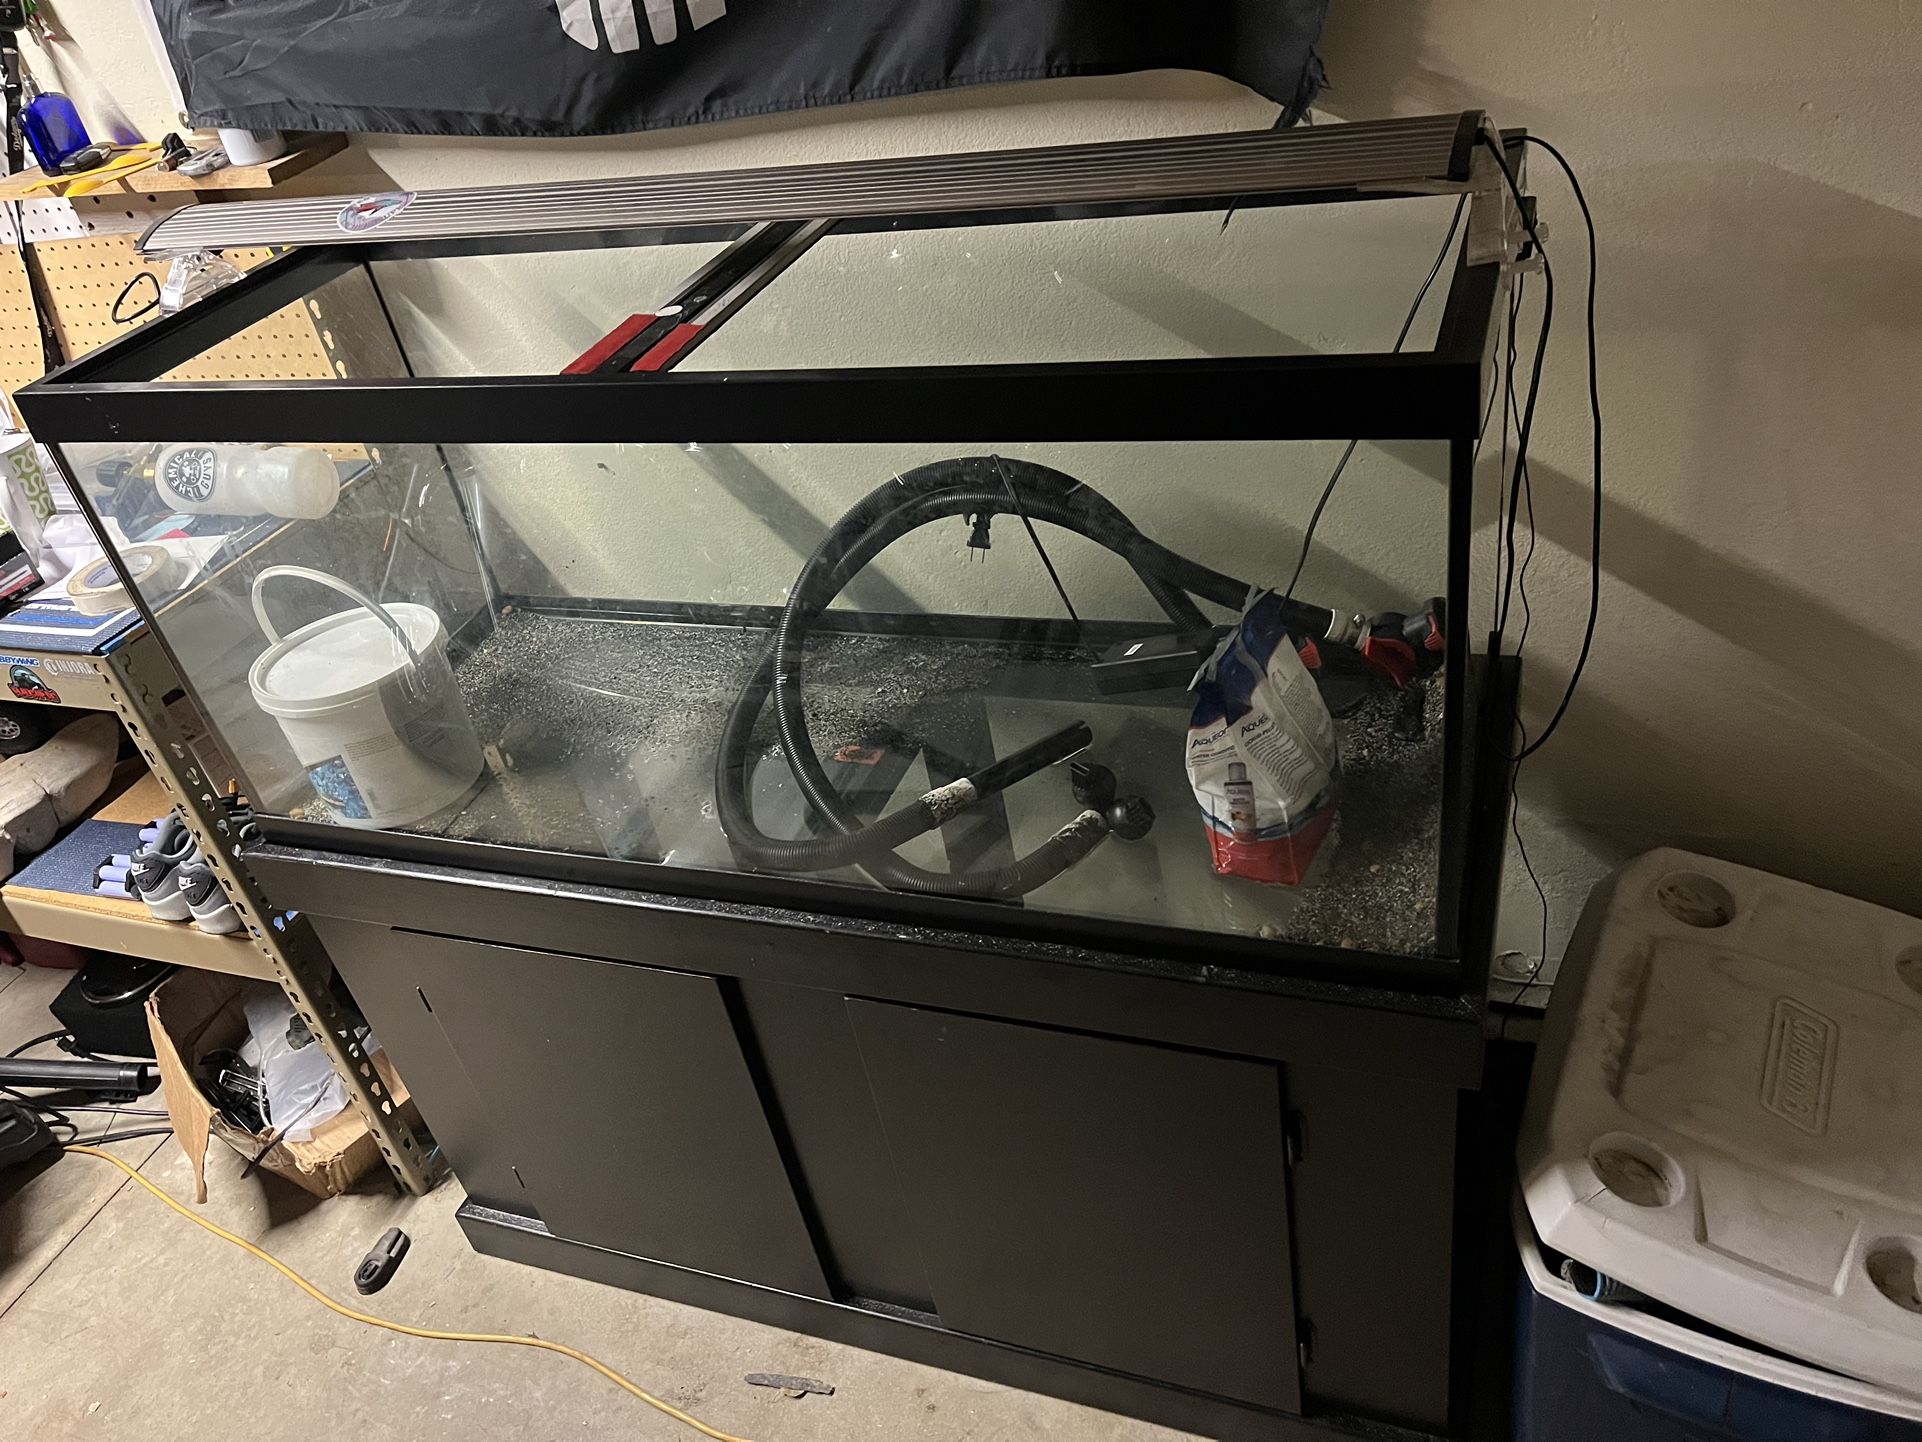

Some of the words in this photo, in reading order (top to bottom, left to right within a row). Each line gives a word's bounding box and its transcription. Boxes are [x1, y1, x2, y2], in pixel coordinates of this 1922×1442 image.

[167, 450, 198, 498] CHEMICAL
[201, 457, 212, 490] GUYS
[1241, 712, 1269, 738] AQUE
